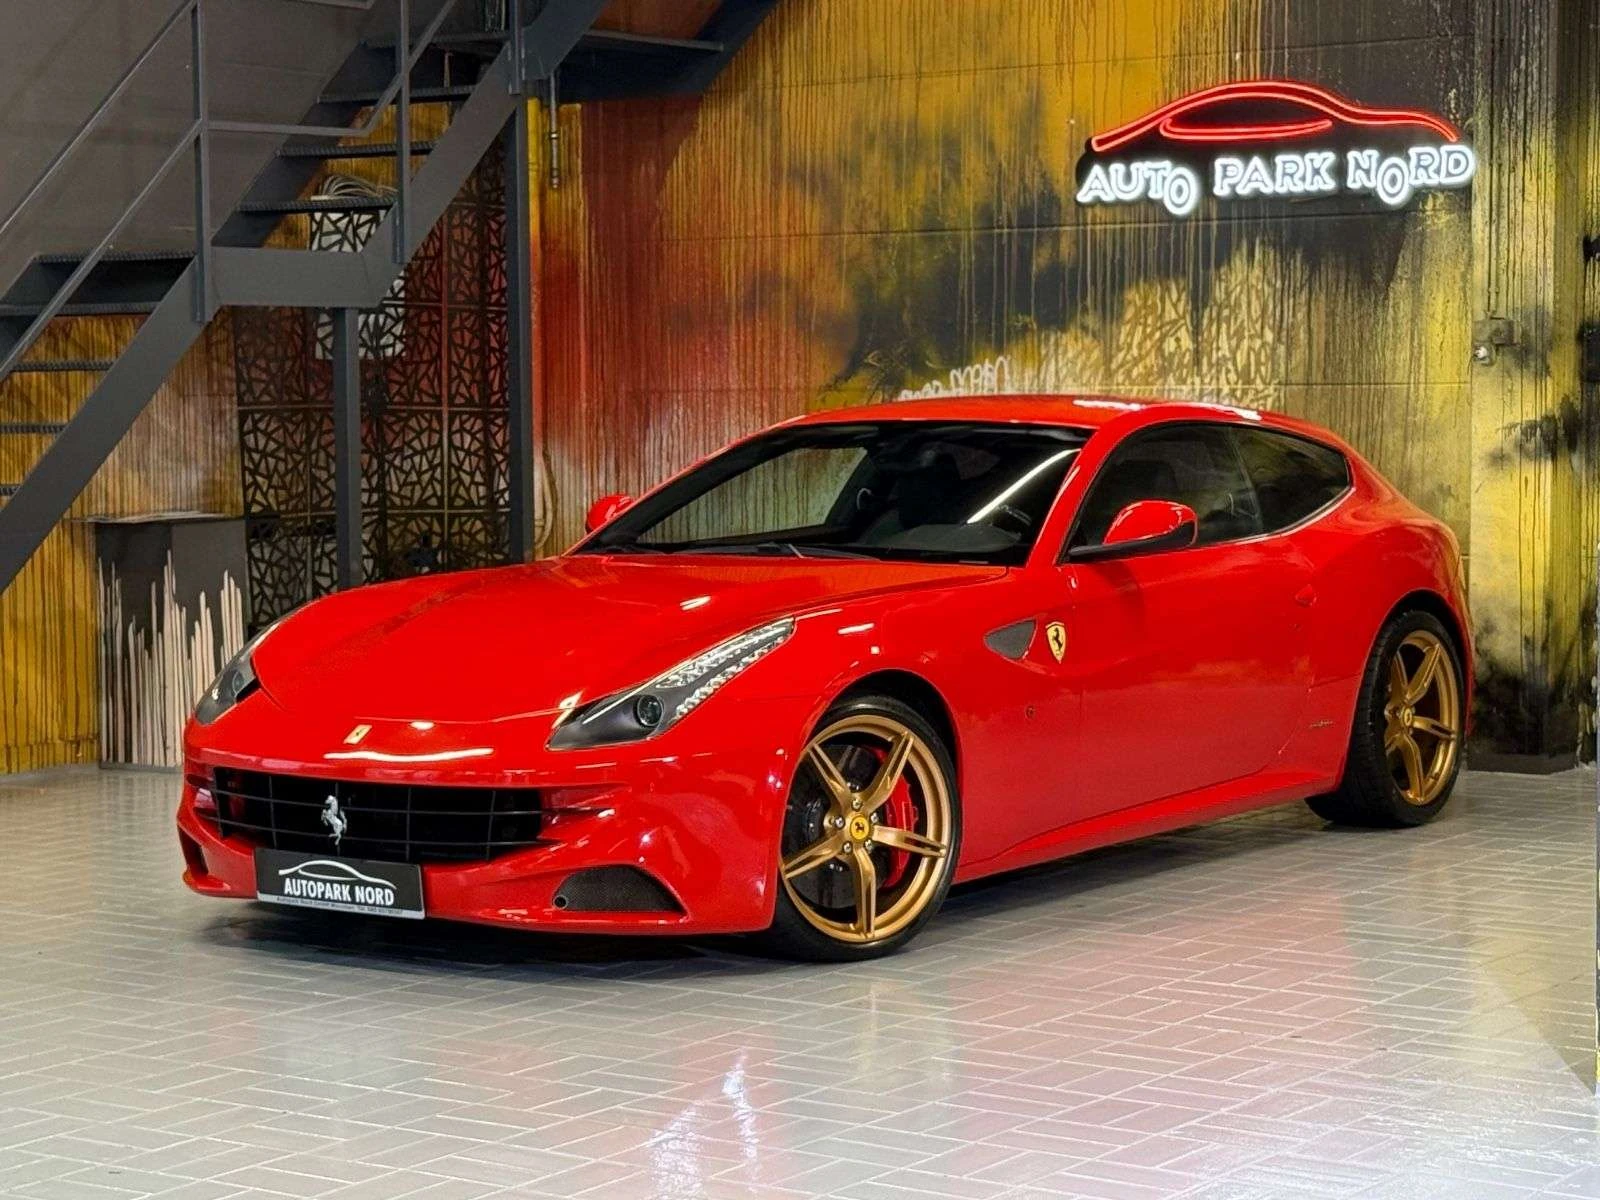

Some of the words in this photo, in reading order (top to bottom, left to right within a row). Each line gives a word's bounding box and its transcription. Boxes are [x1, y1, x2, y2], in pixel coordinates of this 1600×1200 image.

[1076, 160, 1198, 215] AUTO
[1213, 151, 1337, 197] PARK
[1347, 144, 1477, 206] NORD
[284, 877, 351, 902] AUTOPARK
[354, 885, 395, 906] NORD
